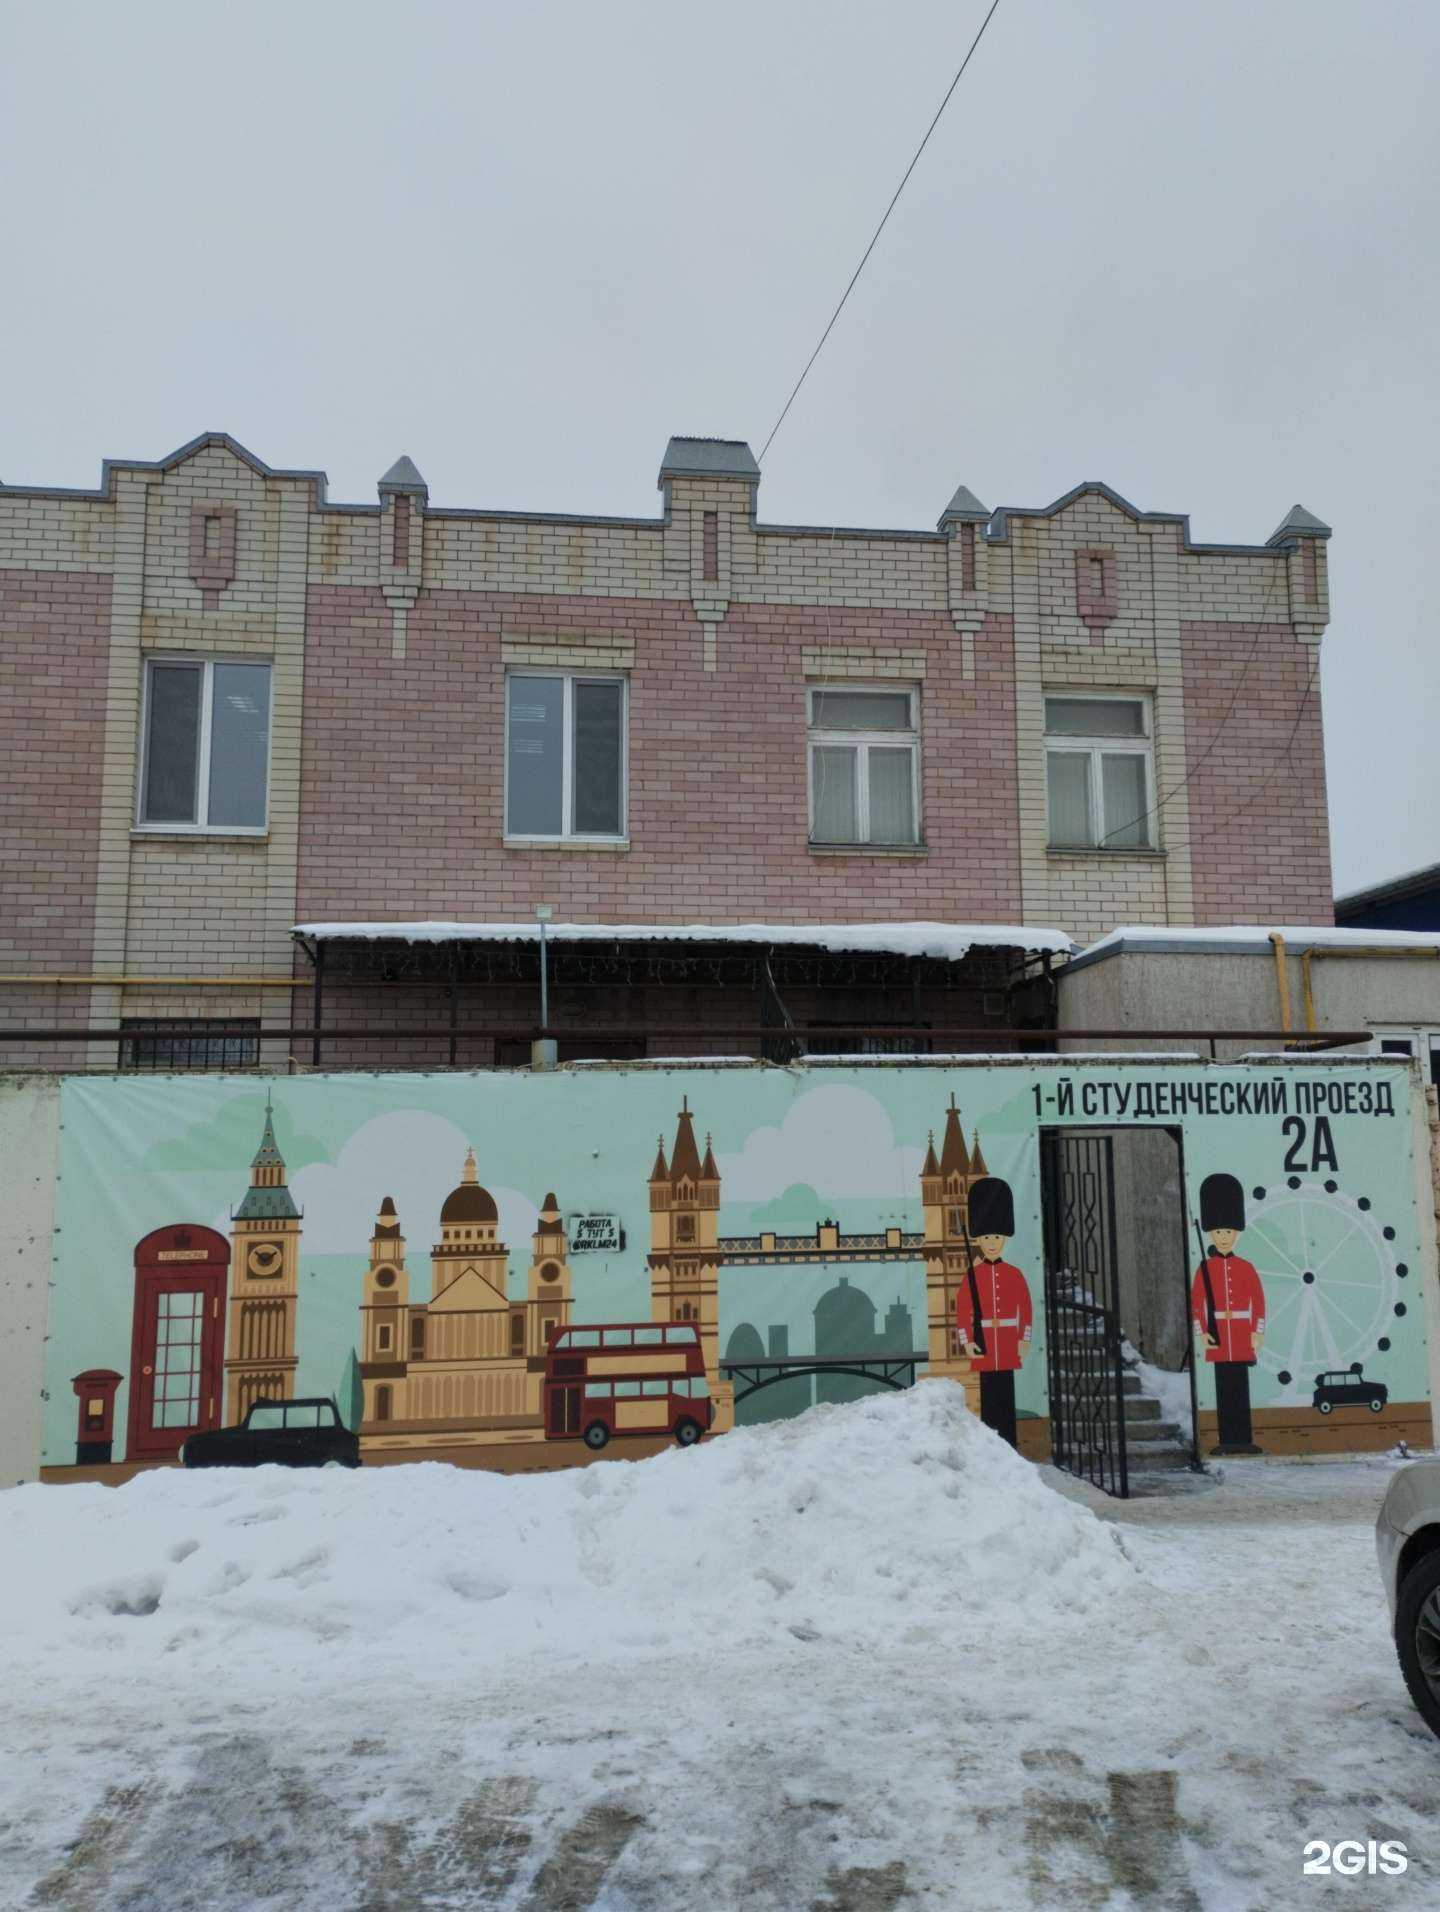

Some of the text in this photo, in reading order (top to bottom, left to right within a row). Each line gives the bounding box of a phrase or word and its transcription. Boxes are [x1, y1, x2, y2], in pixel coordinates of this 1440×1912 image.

[1032, 1076, 1395, 1118] 1-Й СТУДЕНЧЕСКИЙ ПРОЕЗД
[1281, 1116, 1339, 1173] 2А
[579, 1219, 612, 1228] РАБОТА
